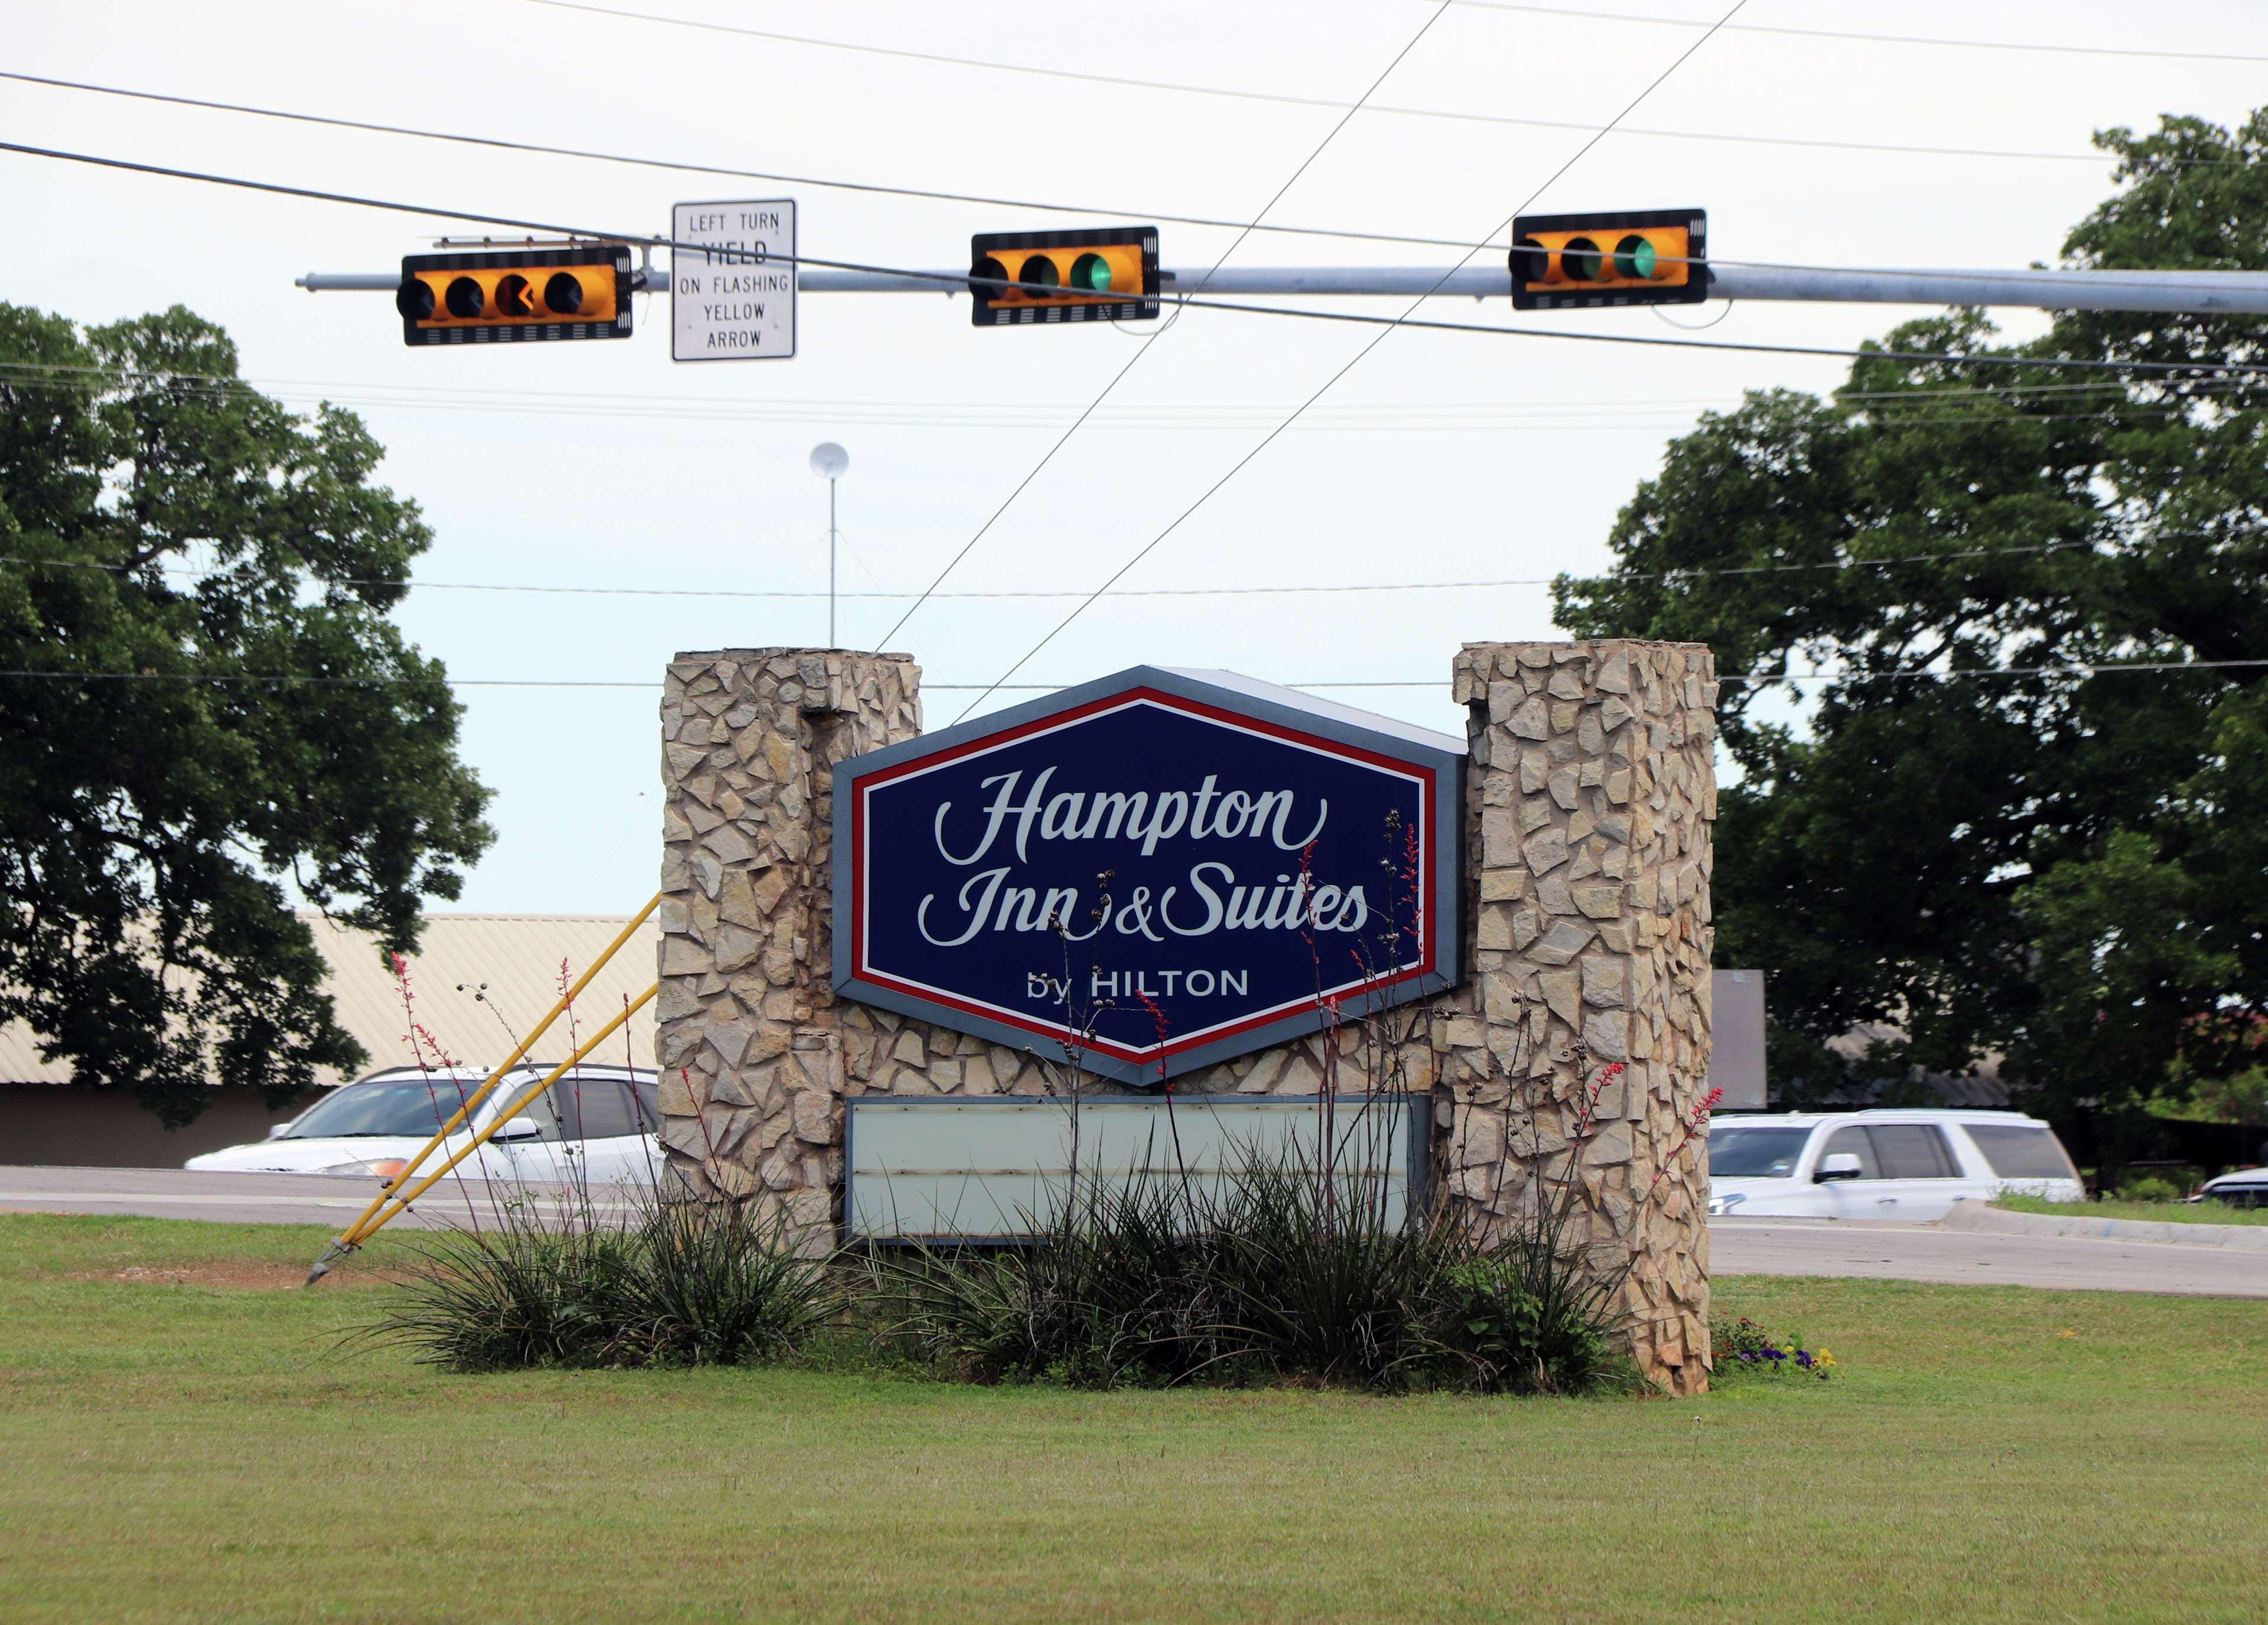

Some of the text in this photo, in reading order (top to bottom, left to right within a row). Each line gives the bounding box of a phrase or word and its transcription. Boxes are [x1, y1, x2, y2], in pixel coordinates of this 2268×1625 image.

[690, 212, 779, 232] LEFT TURN
[703, 240, 767, 266] YIELD
[680, 275, 789, 295] ON FLASHING
[704, 303, 766, 321] YELLOW
[707, 330, 762, 349] ARROW
[935, 766, 1327, 866] Hampton
[918, 862, 1368, 946] Inn & Suites
[1027, 970, 1249, 1005] by HILTON
